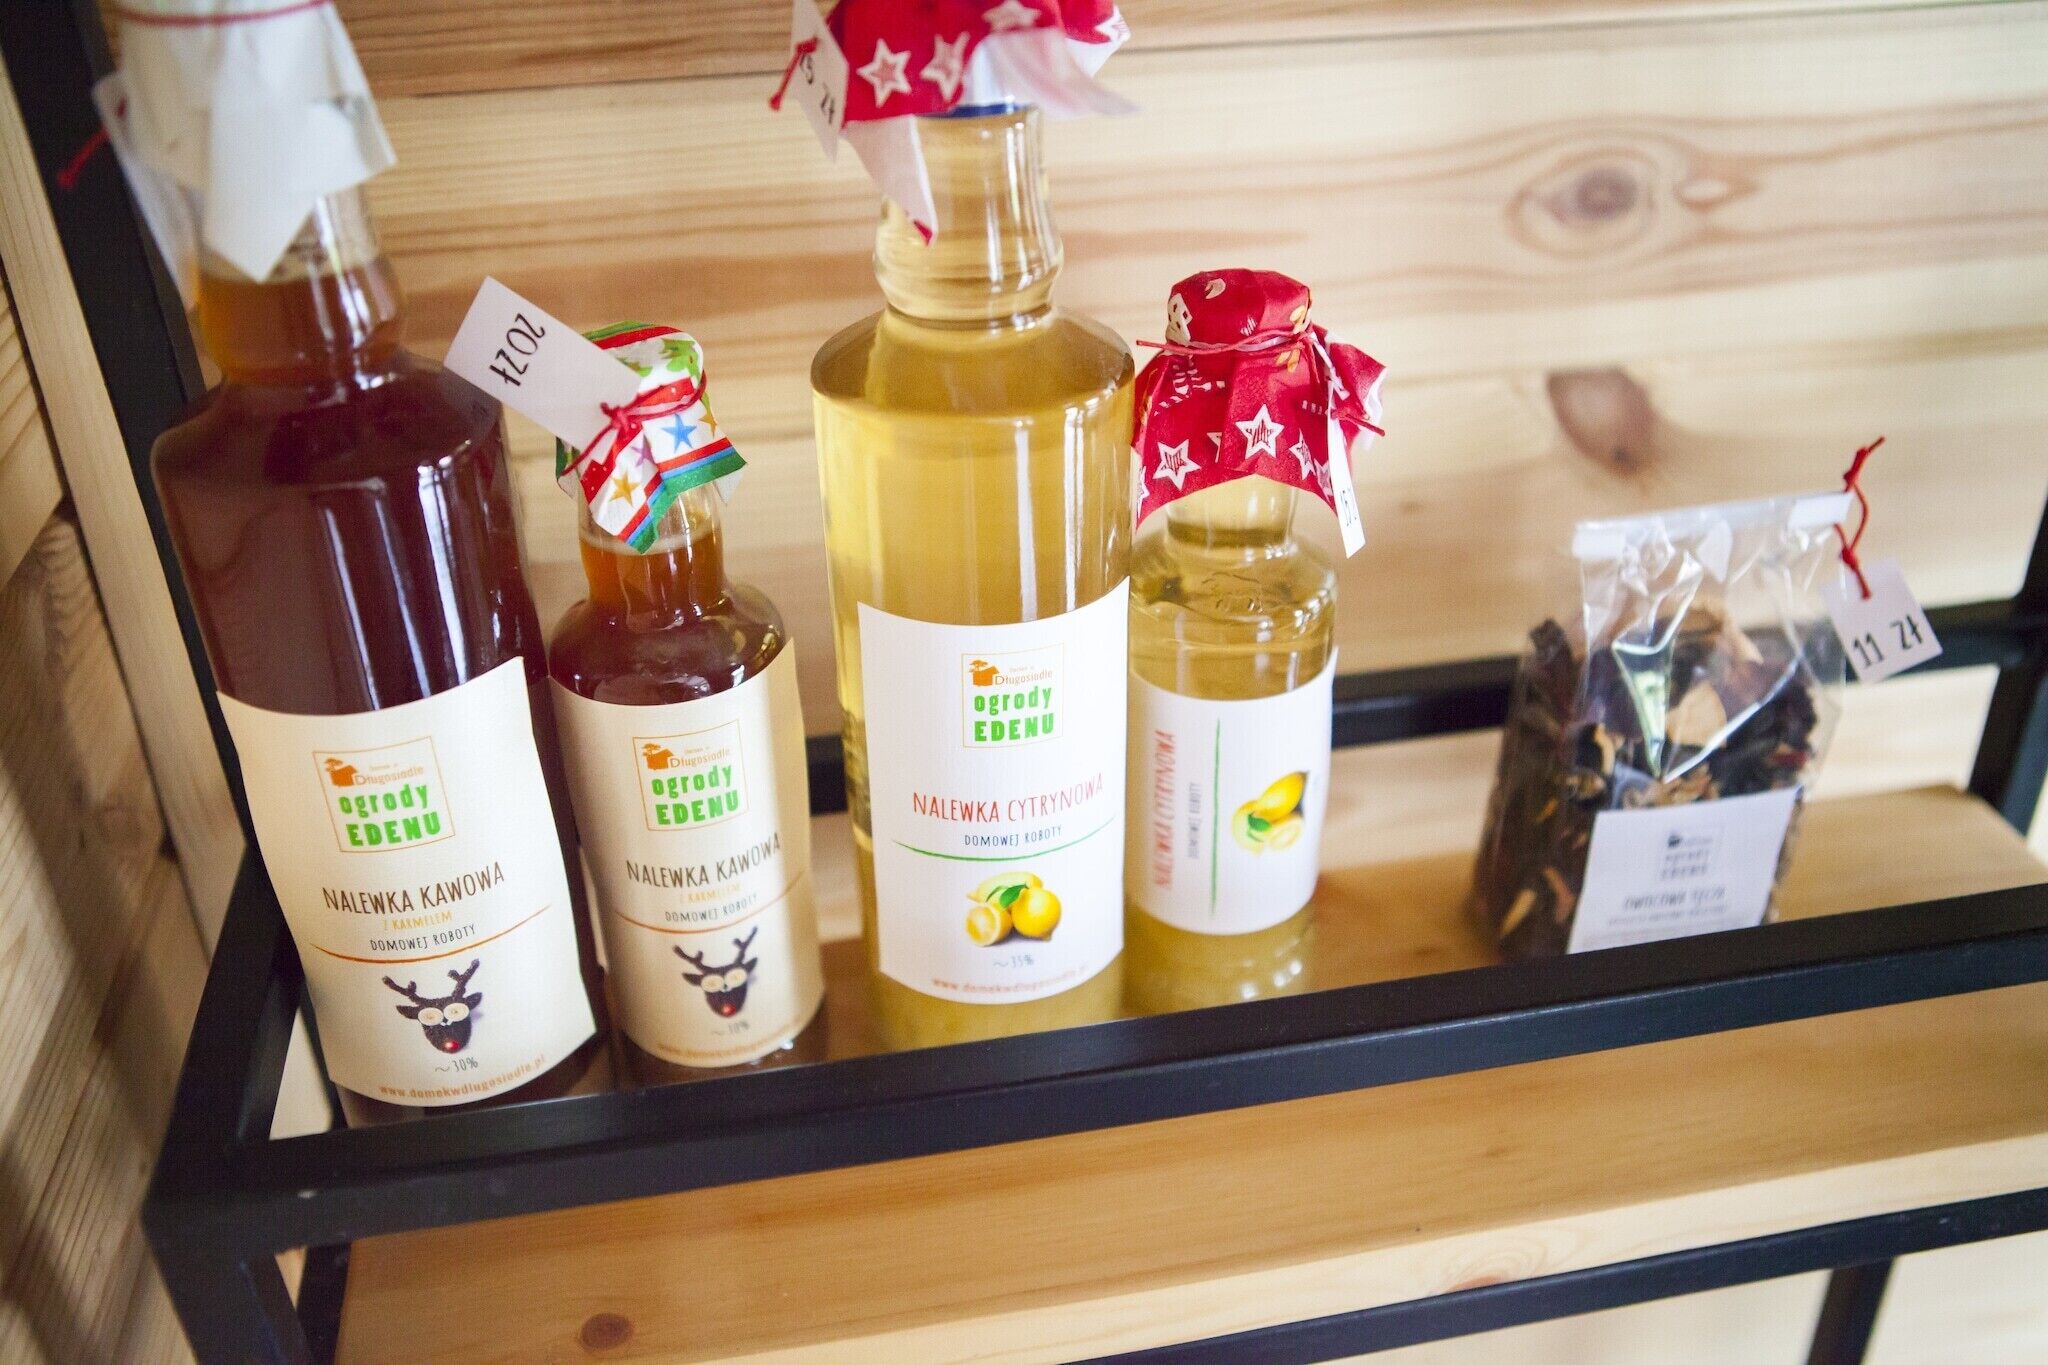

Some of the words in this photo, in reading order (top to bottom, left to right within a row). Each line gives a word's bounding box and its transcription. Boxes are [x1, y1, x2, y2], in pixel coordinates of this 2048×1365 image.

[1853, 632, 1884, 669] 11
[974, 685, 1052, 717] ogrody
[974, 712, 1054, 742] EDENU
[651, 765, 732, 799] ogrody
[912, 791, 1000, 823] NALEWKA
[1007, 771, 1104, 822] CYTRYNOWA
[338, 783, 428, 818] ogrody
[655, 789, 740, 826] EDENU
[346, 811, 441, 847] EDENU
[964, 834, 1020, 847] DOMOWEJ
[1024, 825, 1062, 844] ROBOTY
[626, 859, 710, 889] NALEWKA
[716, 831, 781, 883] KAWOWA
[322, 886, 415, 915] NALEWKA
[419, 861, 505, 909] KAWOWA
[392, 911, 453, 930] KARMELEM
[664, 908, 718, 923] DOMOWEJ
[723, 893, 758, 916] ROBOTY
[369, 935, 429, 951] DOMOWEJ
[433, 923, 477, 946] ROBOTY
